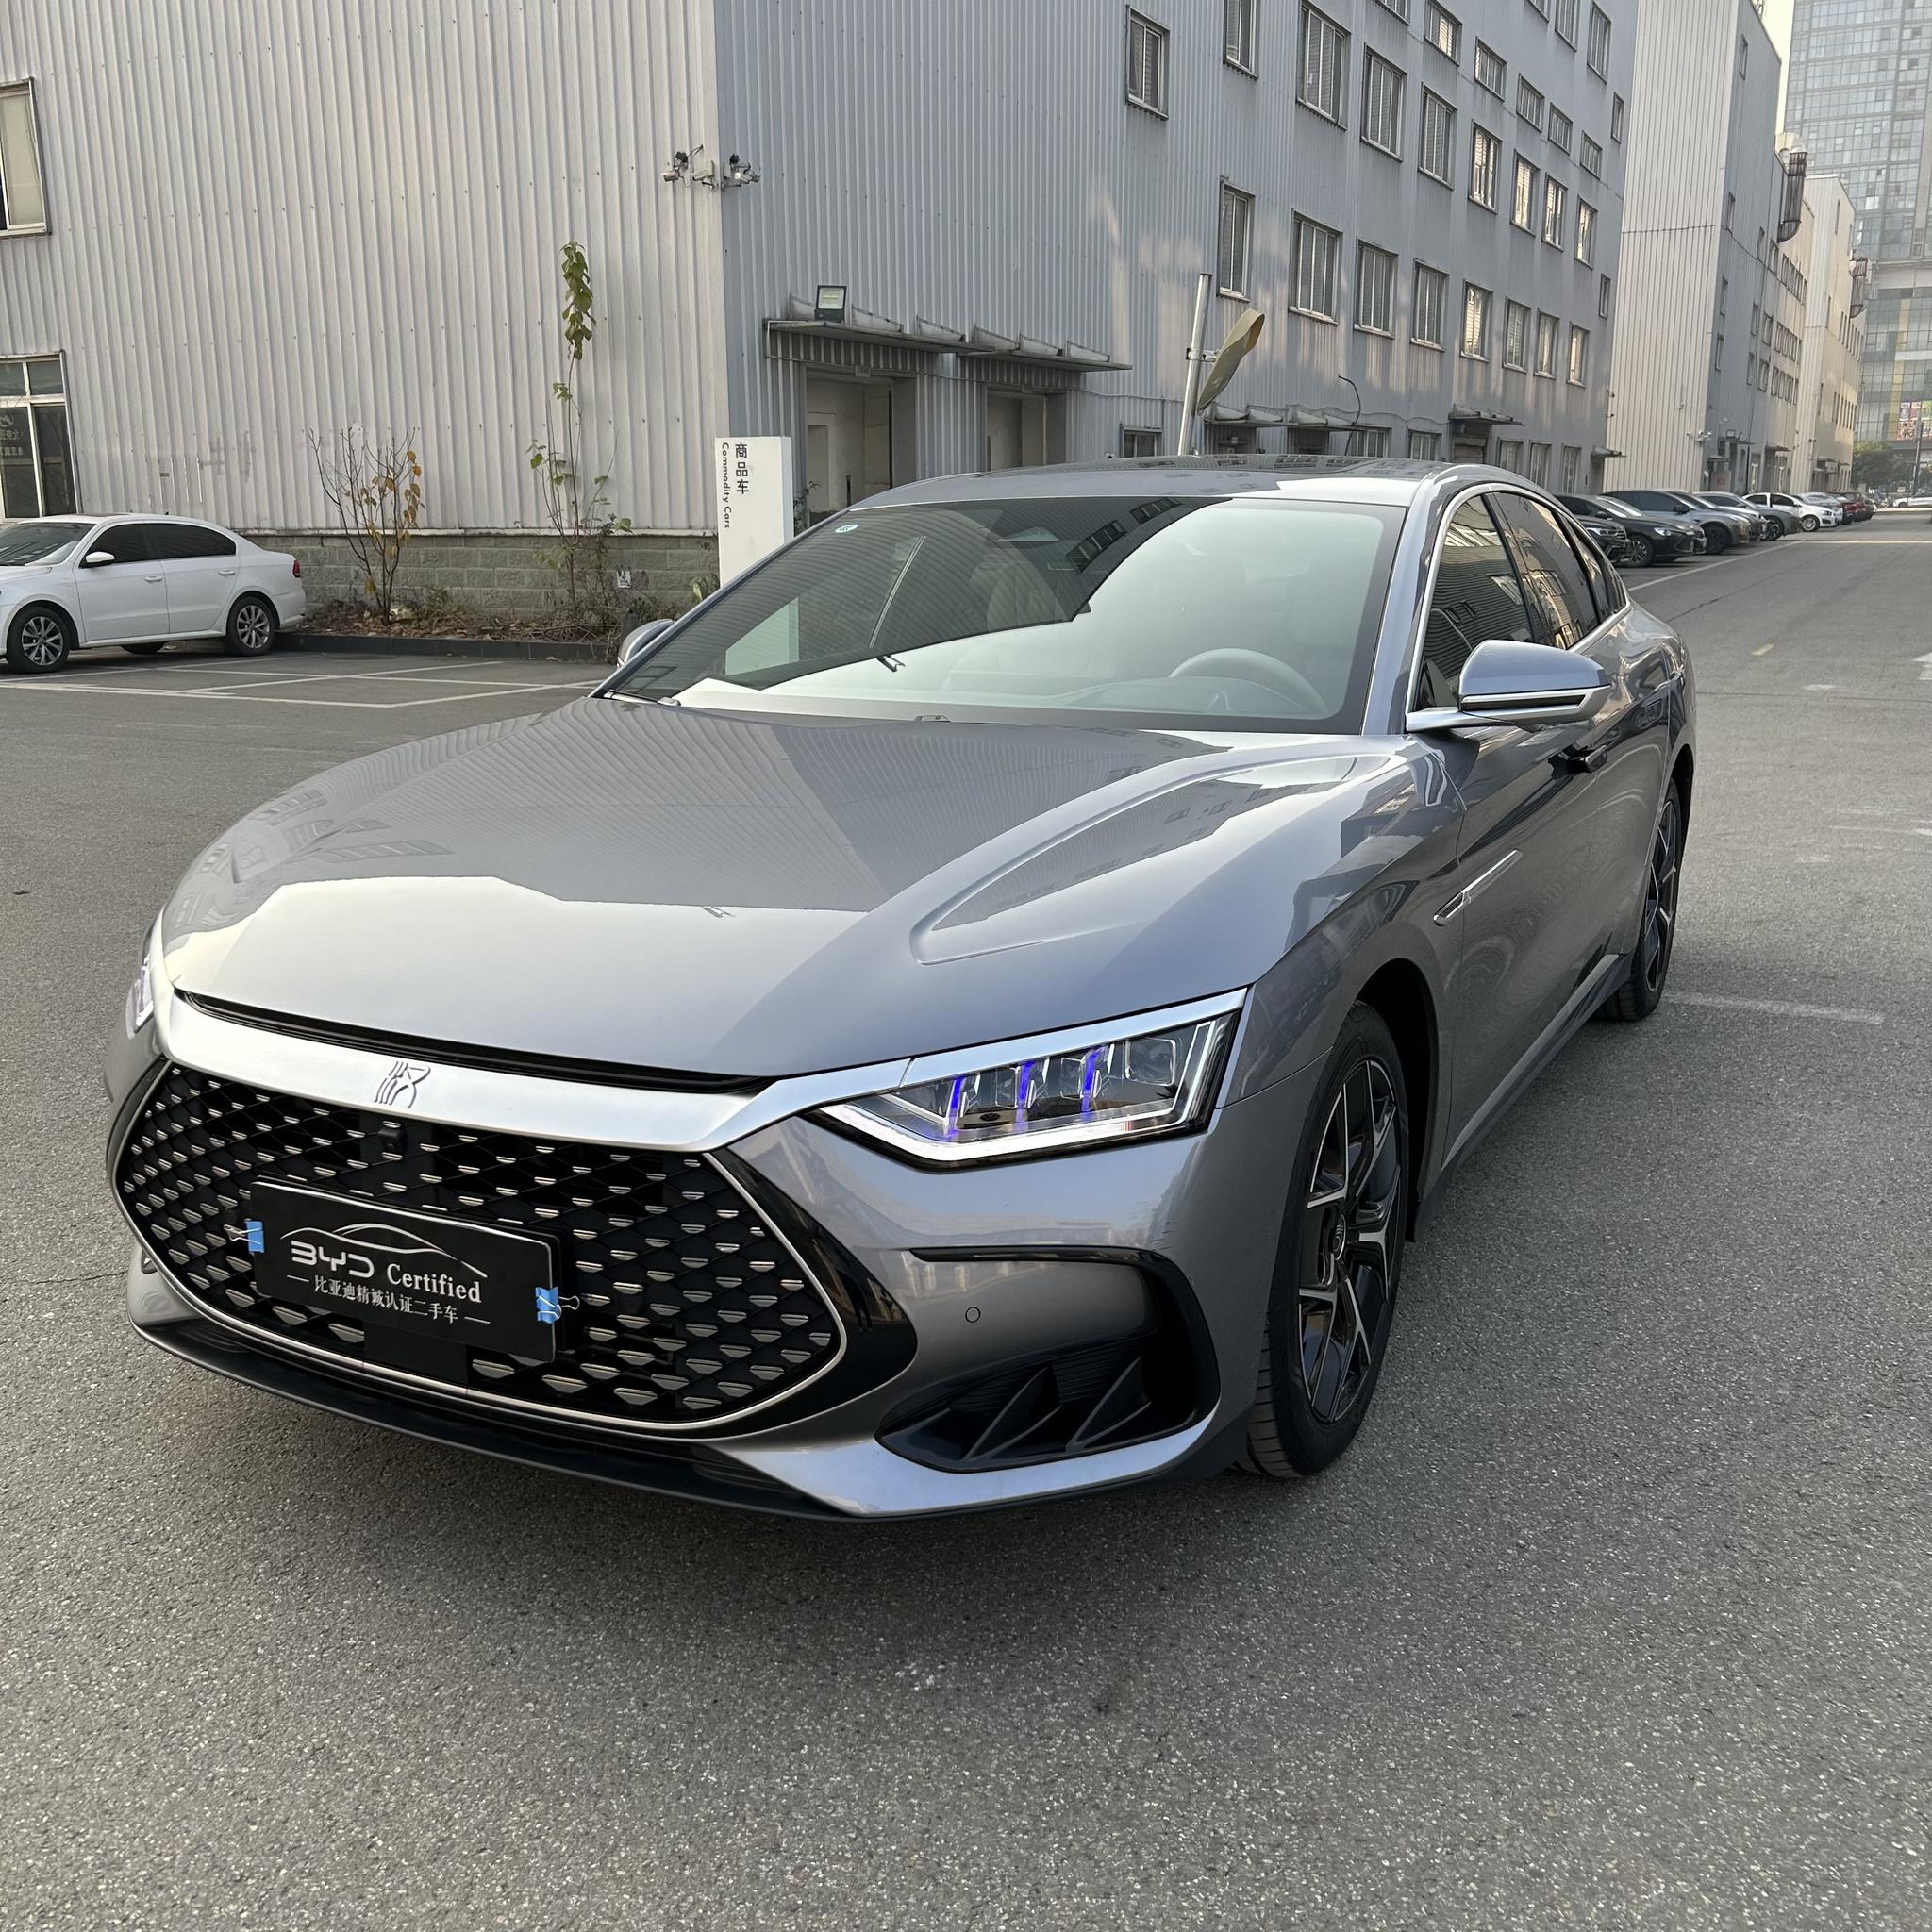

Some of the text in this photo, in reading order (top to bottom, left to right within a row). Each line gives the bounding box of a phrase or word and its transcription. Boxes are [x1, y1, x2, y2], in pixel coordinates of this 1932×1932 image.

[722, 442, 732, 528] Commodity Cars
[735, 442, 749, 494] 商品车
[291, 1240, 483, 1304] BYD Certified
[313, 1275, 459, 1324] 比亚迪精诚认证二手车
